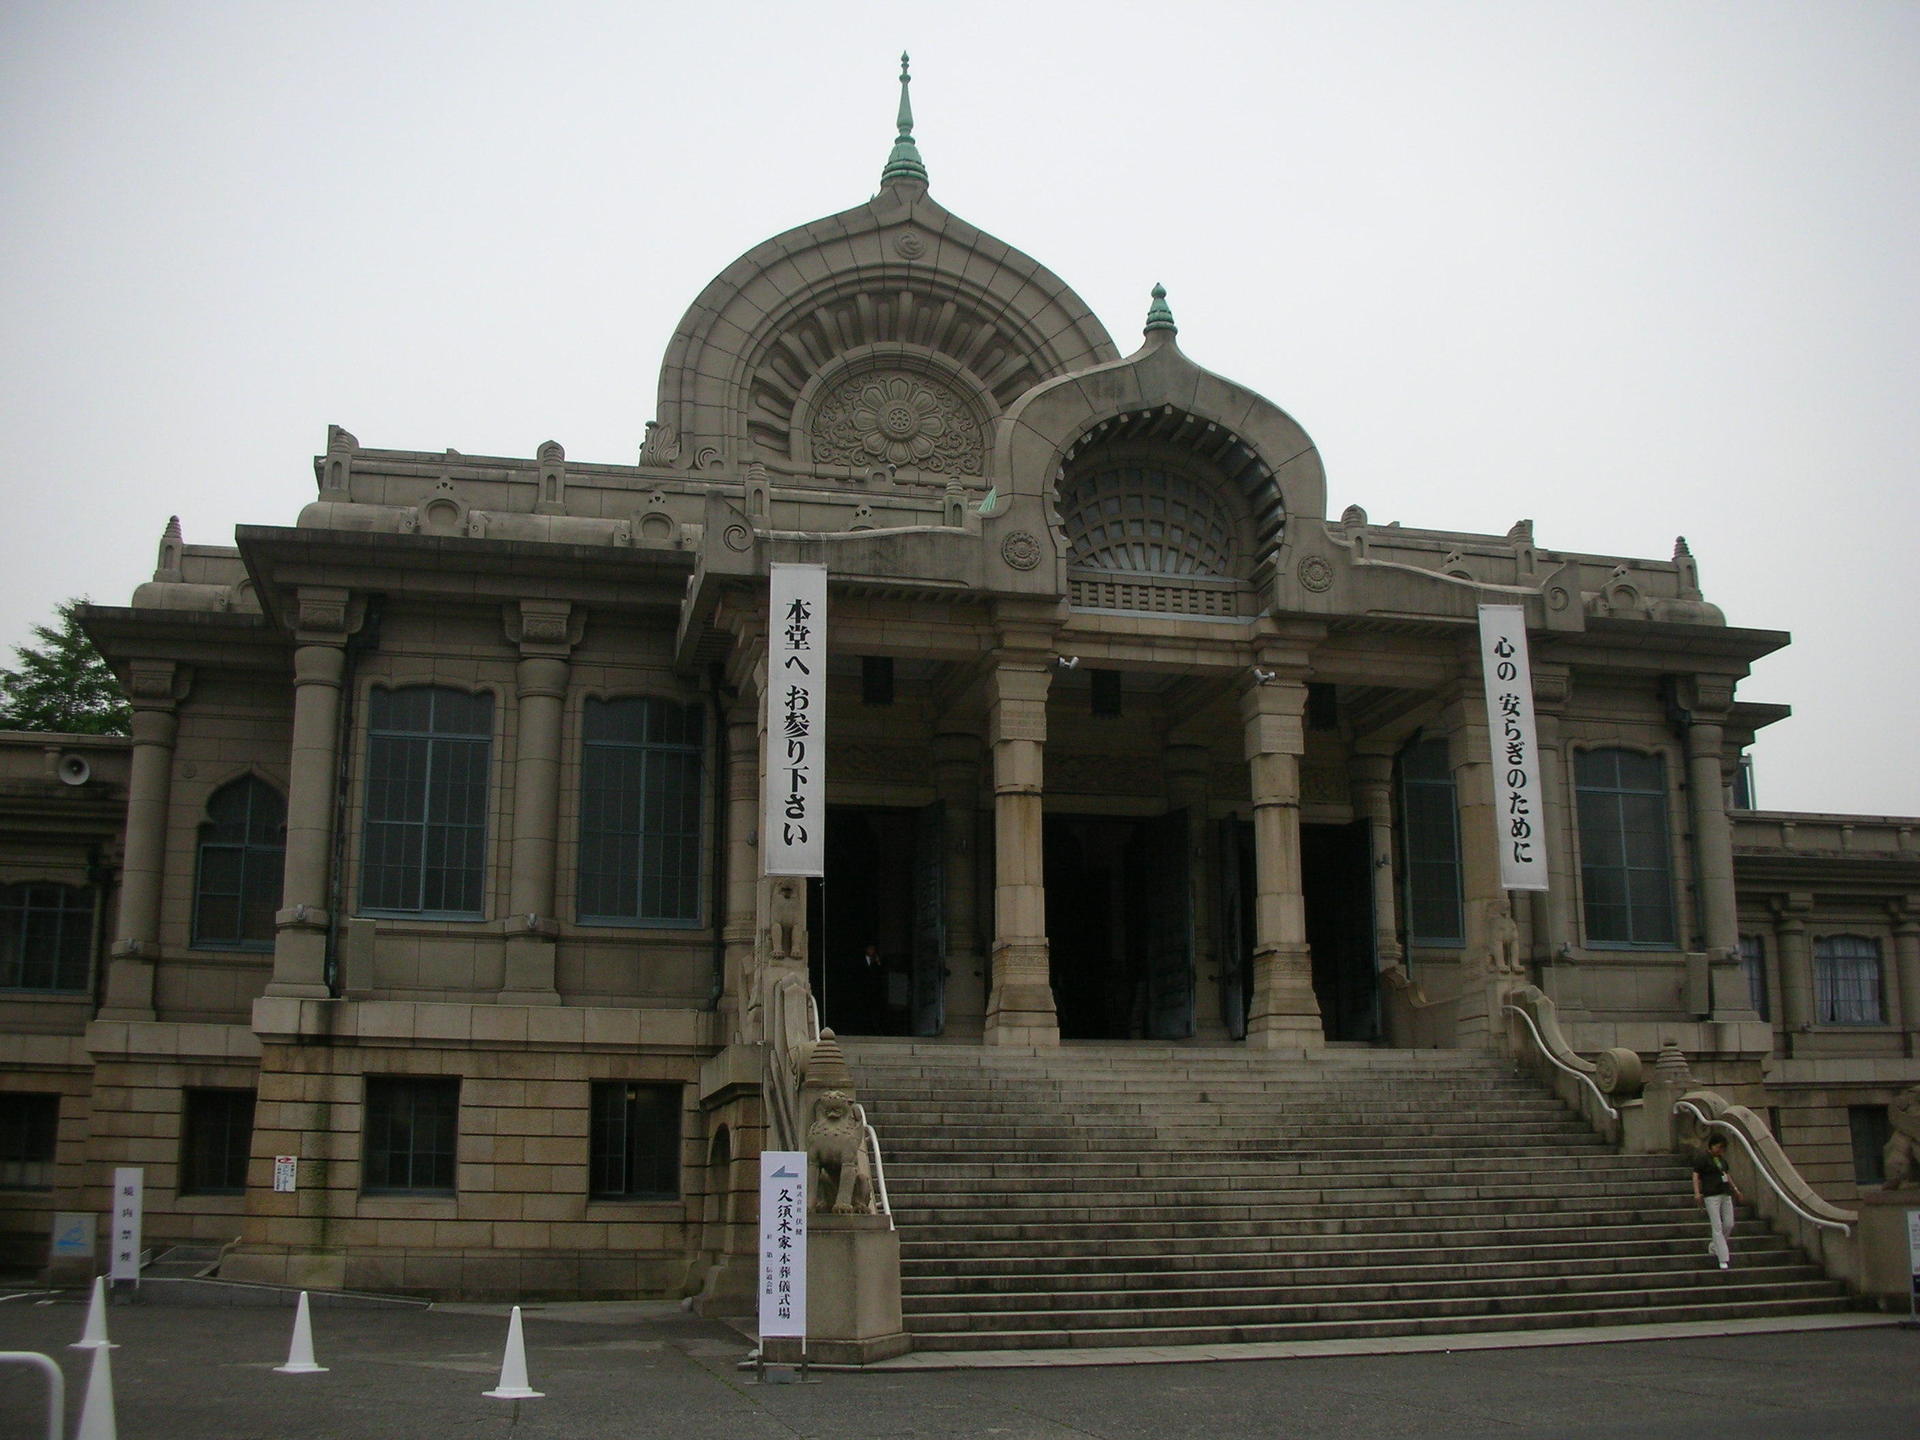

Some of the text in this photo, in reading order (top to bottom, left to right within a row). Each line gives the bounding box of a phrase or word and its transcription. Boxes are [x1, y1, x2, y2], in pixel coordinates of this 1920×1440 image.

[783, 599, 811, 846] 本堂へ お参り下さい
[1494, 636, 1533, 864] 心の 安らぎのために
